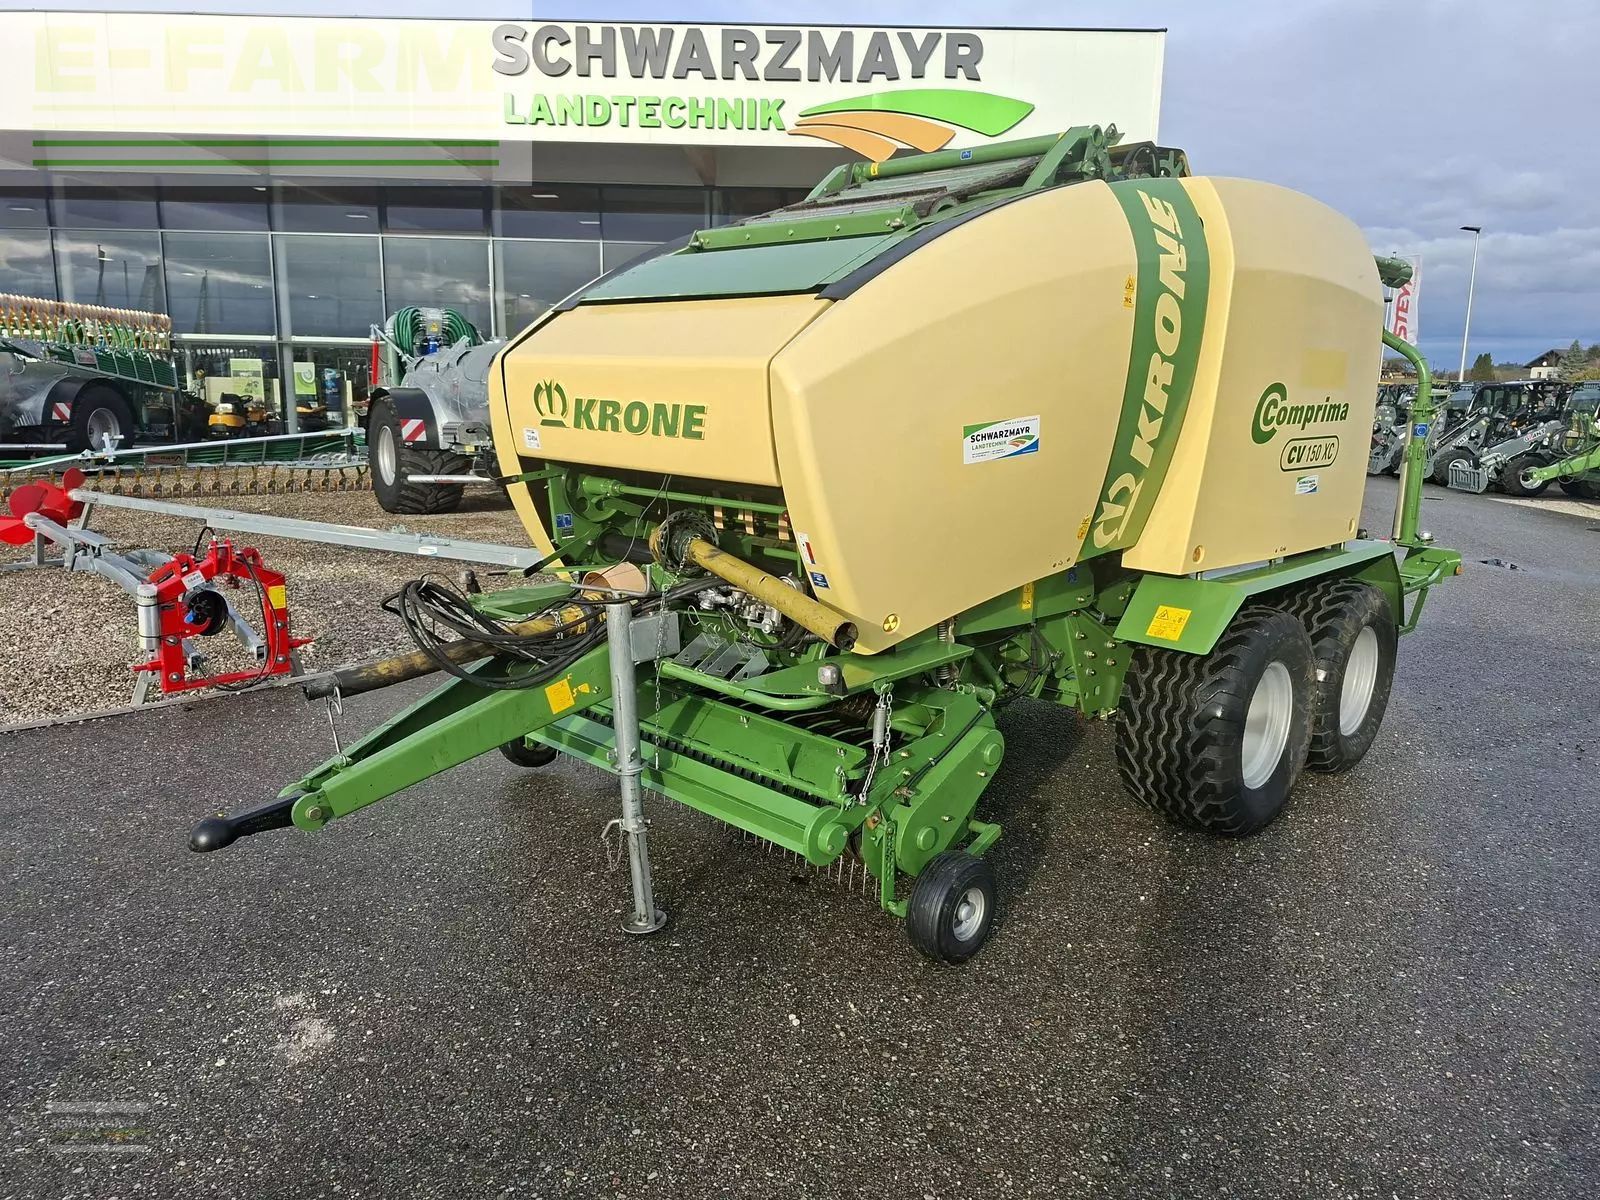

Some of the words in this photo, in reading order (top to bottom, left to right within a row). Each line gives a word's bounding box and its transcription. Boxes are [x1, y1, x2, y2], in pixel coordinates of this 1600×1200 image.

[492, 24, 984, 82] SCHWARZMAYR
[505, 93, 786, 131] LANDTECHNIK
[1130, 189, 1187, 468] KRONE
[1394, 280, 1412, 340] STEY
[573, 398, 706, 440] KRONE
[1252, 384, 1349, 440] Comprima
[970, 426, 1030, 443] SCHWARZMAYR
[971, 440, 1007, 450] LANDTECHNIK
[1287, 445, 1306, 464] CV
[1306, 444, 1321, 462] 150
[1322, 442, 1334, 460] XC
